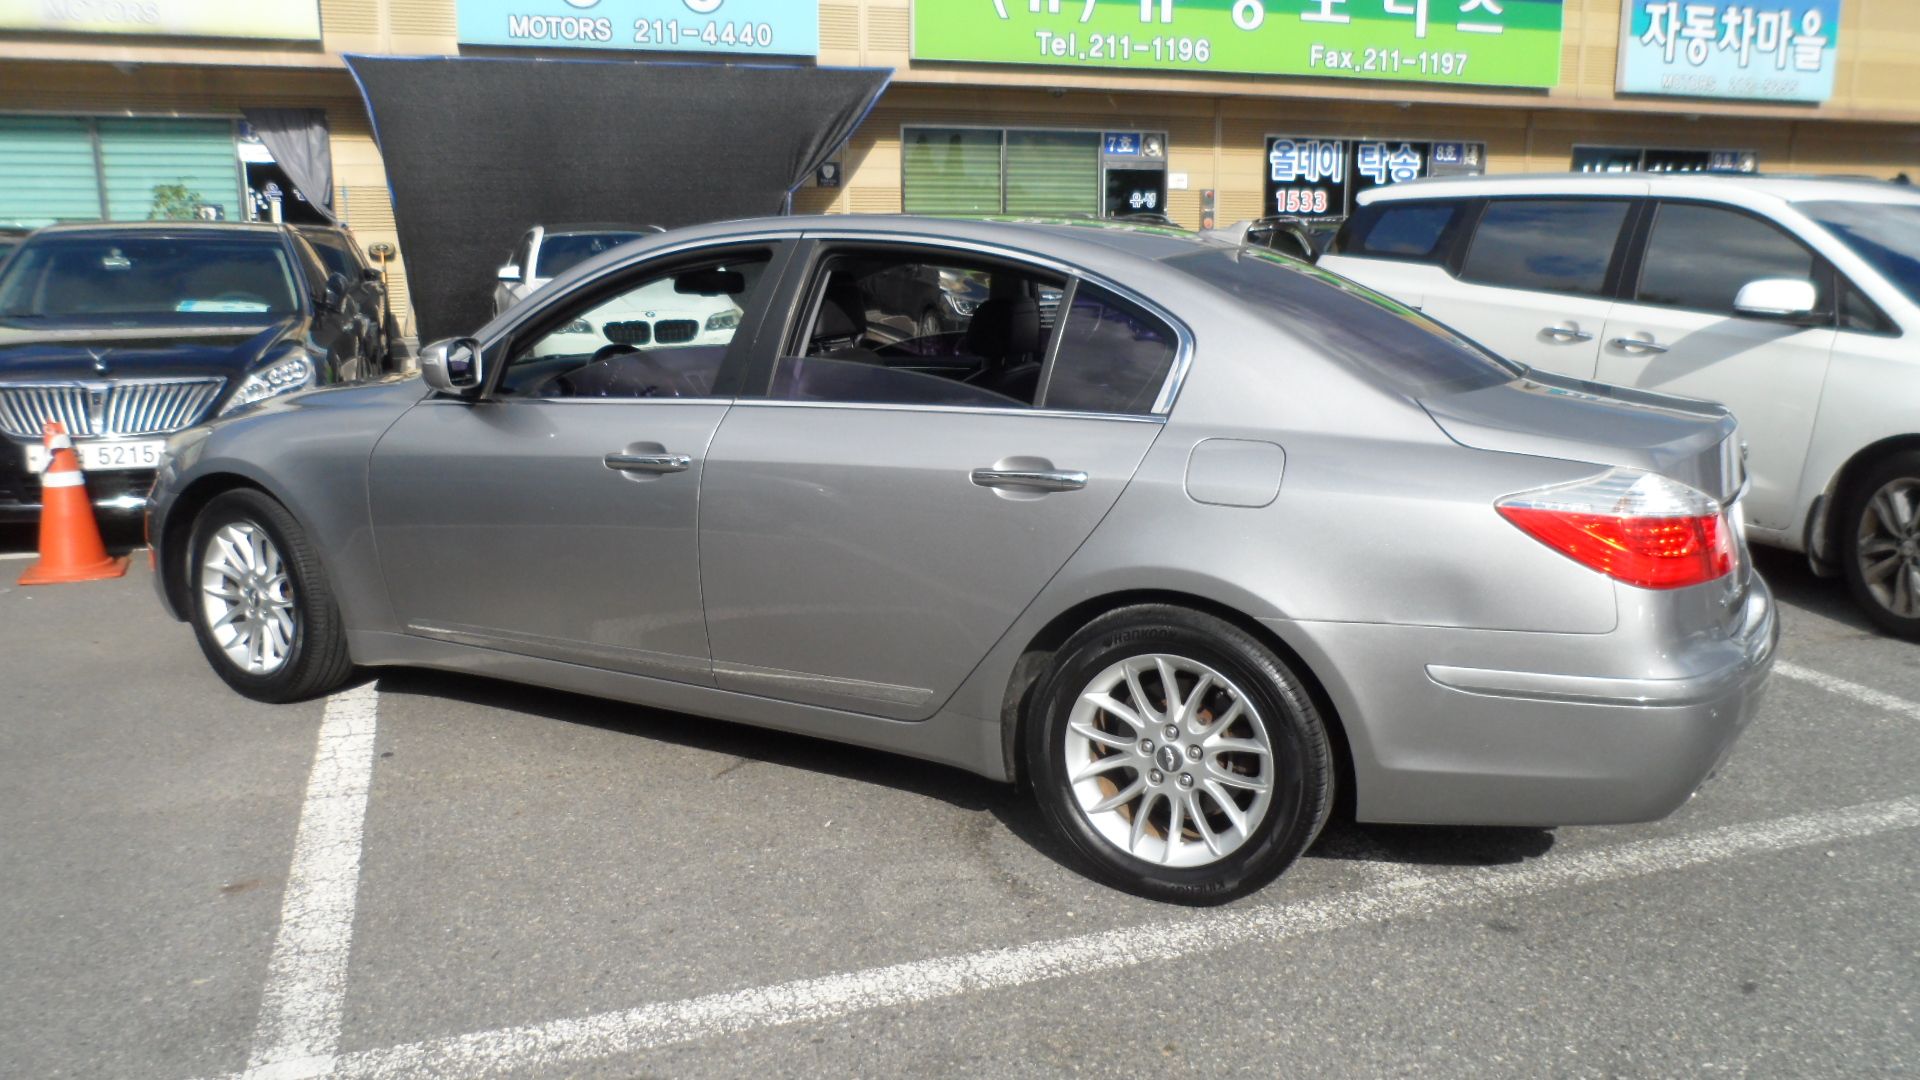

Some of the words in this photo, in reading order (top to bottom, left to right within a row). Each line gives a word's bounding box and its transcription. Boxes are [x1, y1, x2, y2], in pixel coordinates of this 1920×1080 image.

[508, 15, 613, 42] MOTORS
[633, 19, 773, 47] 211-4440
[1035, 31, 1211, 63] Tel.211-1196
[1640, 2, 1828, 72] 자동차마을
[1310, 44, 1468, 76] Fax.211-1197
[1108, 136, 1134, 153] 7호
[1435, 145, 1458, 162] 8호
[1269, 138, 1343, 184] 올데이
[1357, 142, 1421, 185] 탁송
[1275, 189, 1328, 213] 1533
[98, 445, 156, 466] 5215
